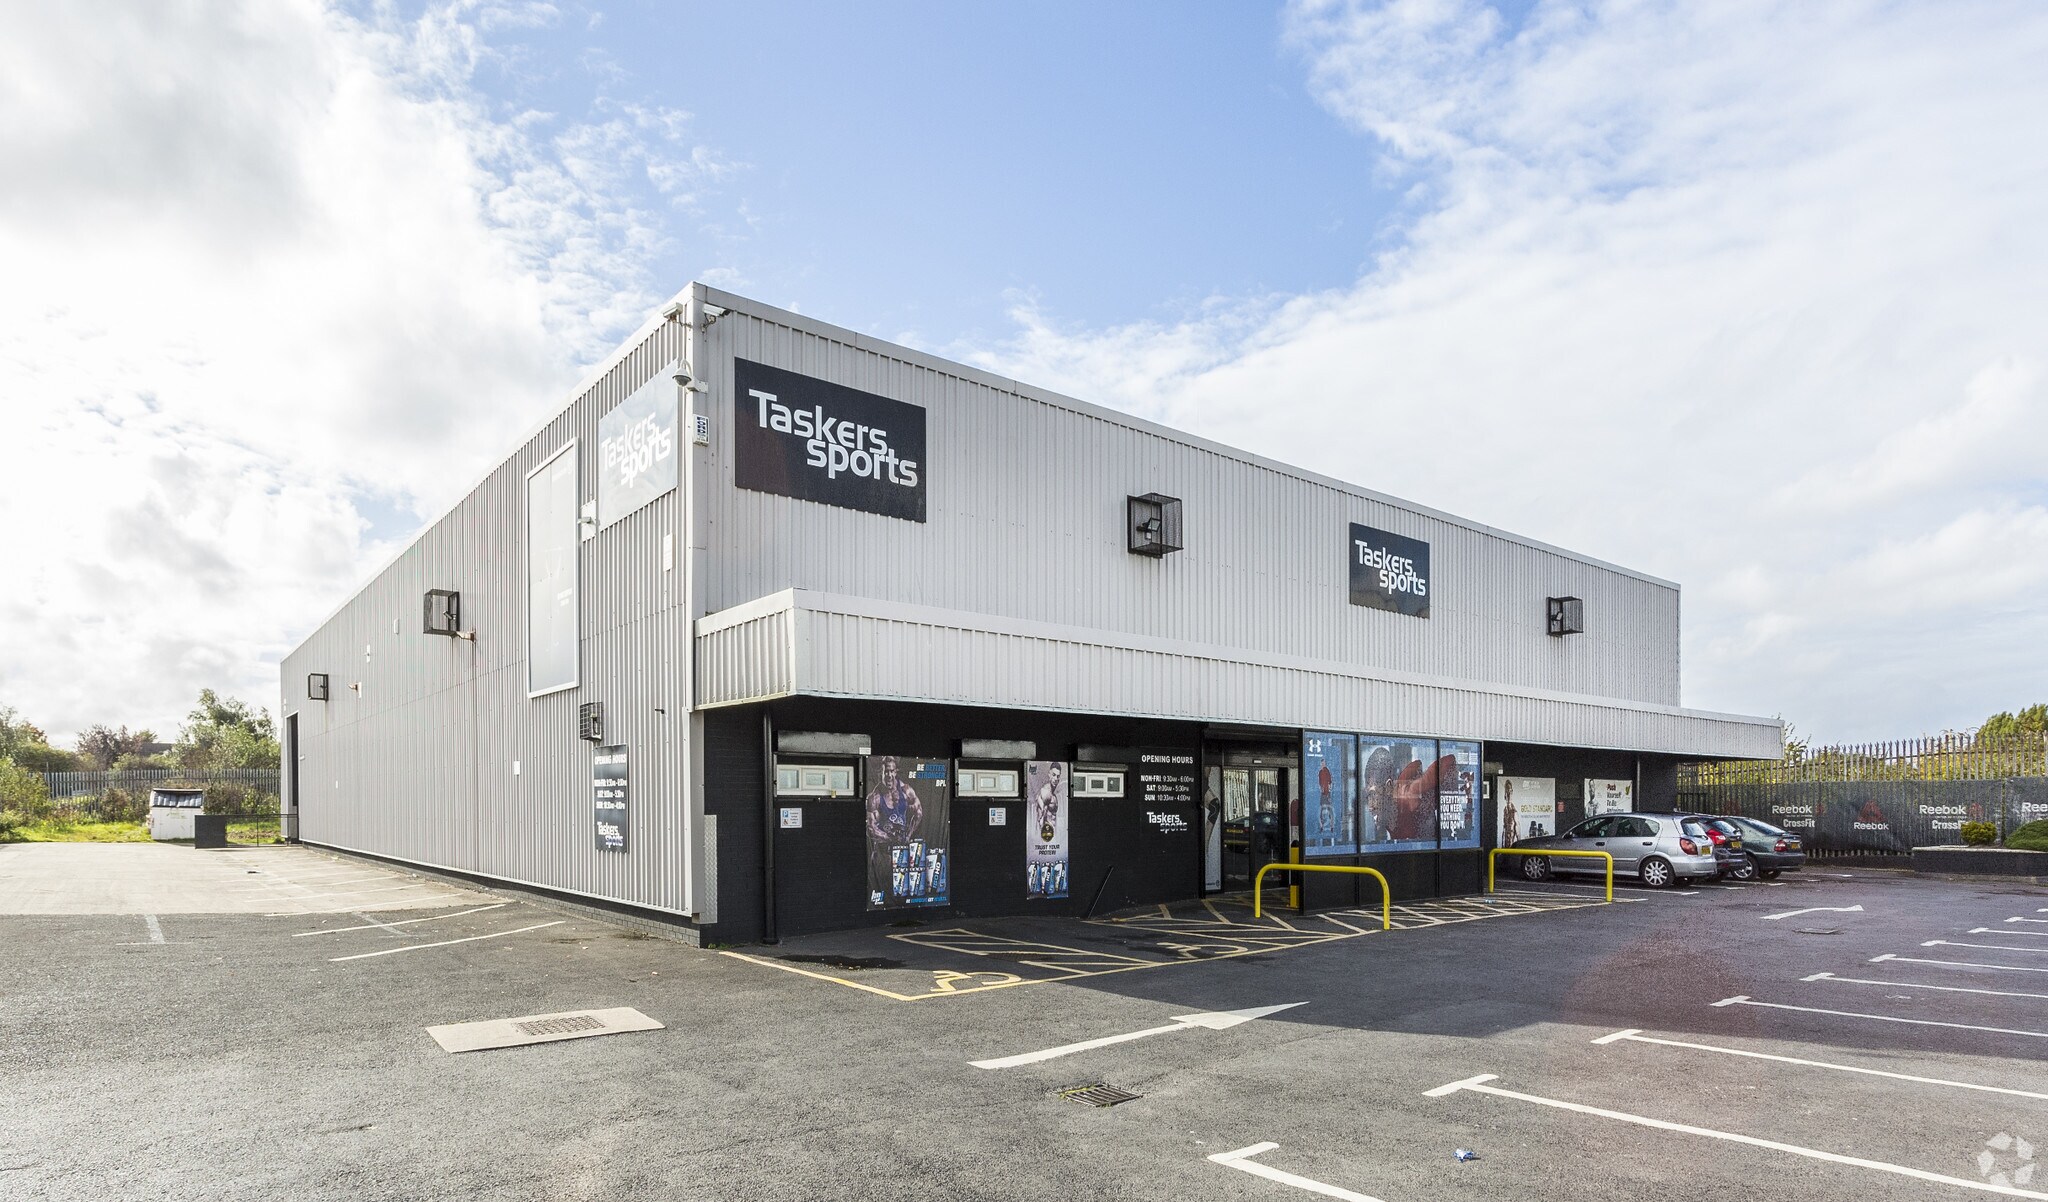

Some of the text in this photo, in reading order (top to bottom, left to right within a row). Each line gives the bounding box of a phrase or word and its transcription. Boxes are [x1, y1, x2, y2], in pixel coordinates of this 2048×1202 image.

[748, 388, 888, 455] Taskers
[601, 411, 656, 472] Taskers
[620, 425, 671, 489] sports
[807, 438, 918, 488] sports
[1354, 539, 1413, 576] Taskers
[1379, 569, 1426, 597] sports
[1141, 755, 1193, 764] OPENING HOURS
[916, 763, 925, 771] BE
[908, 771, 917, 779] BE
[1440, 804, 1449, 812] YOU
[1771, 805, 1812, 814] Reebok
[1919, 804, 1967, 815] Reebok
[2021, 802, 2048, 812] Ree
[1146, 811, 1180, 824] Taskers
[1783, 818, 1815, 828] CrossFit
[597, 821, 619, 836] Taskers
[1159, 820, 1188, 834] sports
[1440, 820, 1449, 830] YOU
[1853, 821, 1889, 830] Reebok
[1932, 820, 1967, 830] CrossF
[605, 833, 624, 848] sports
